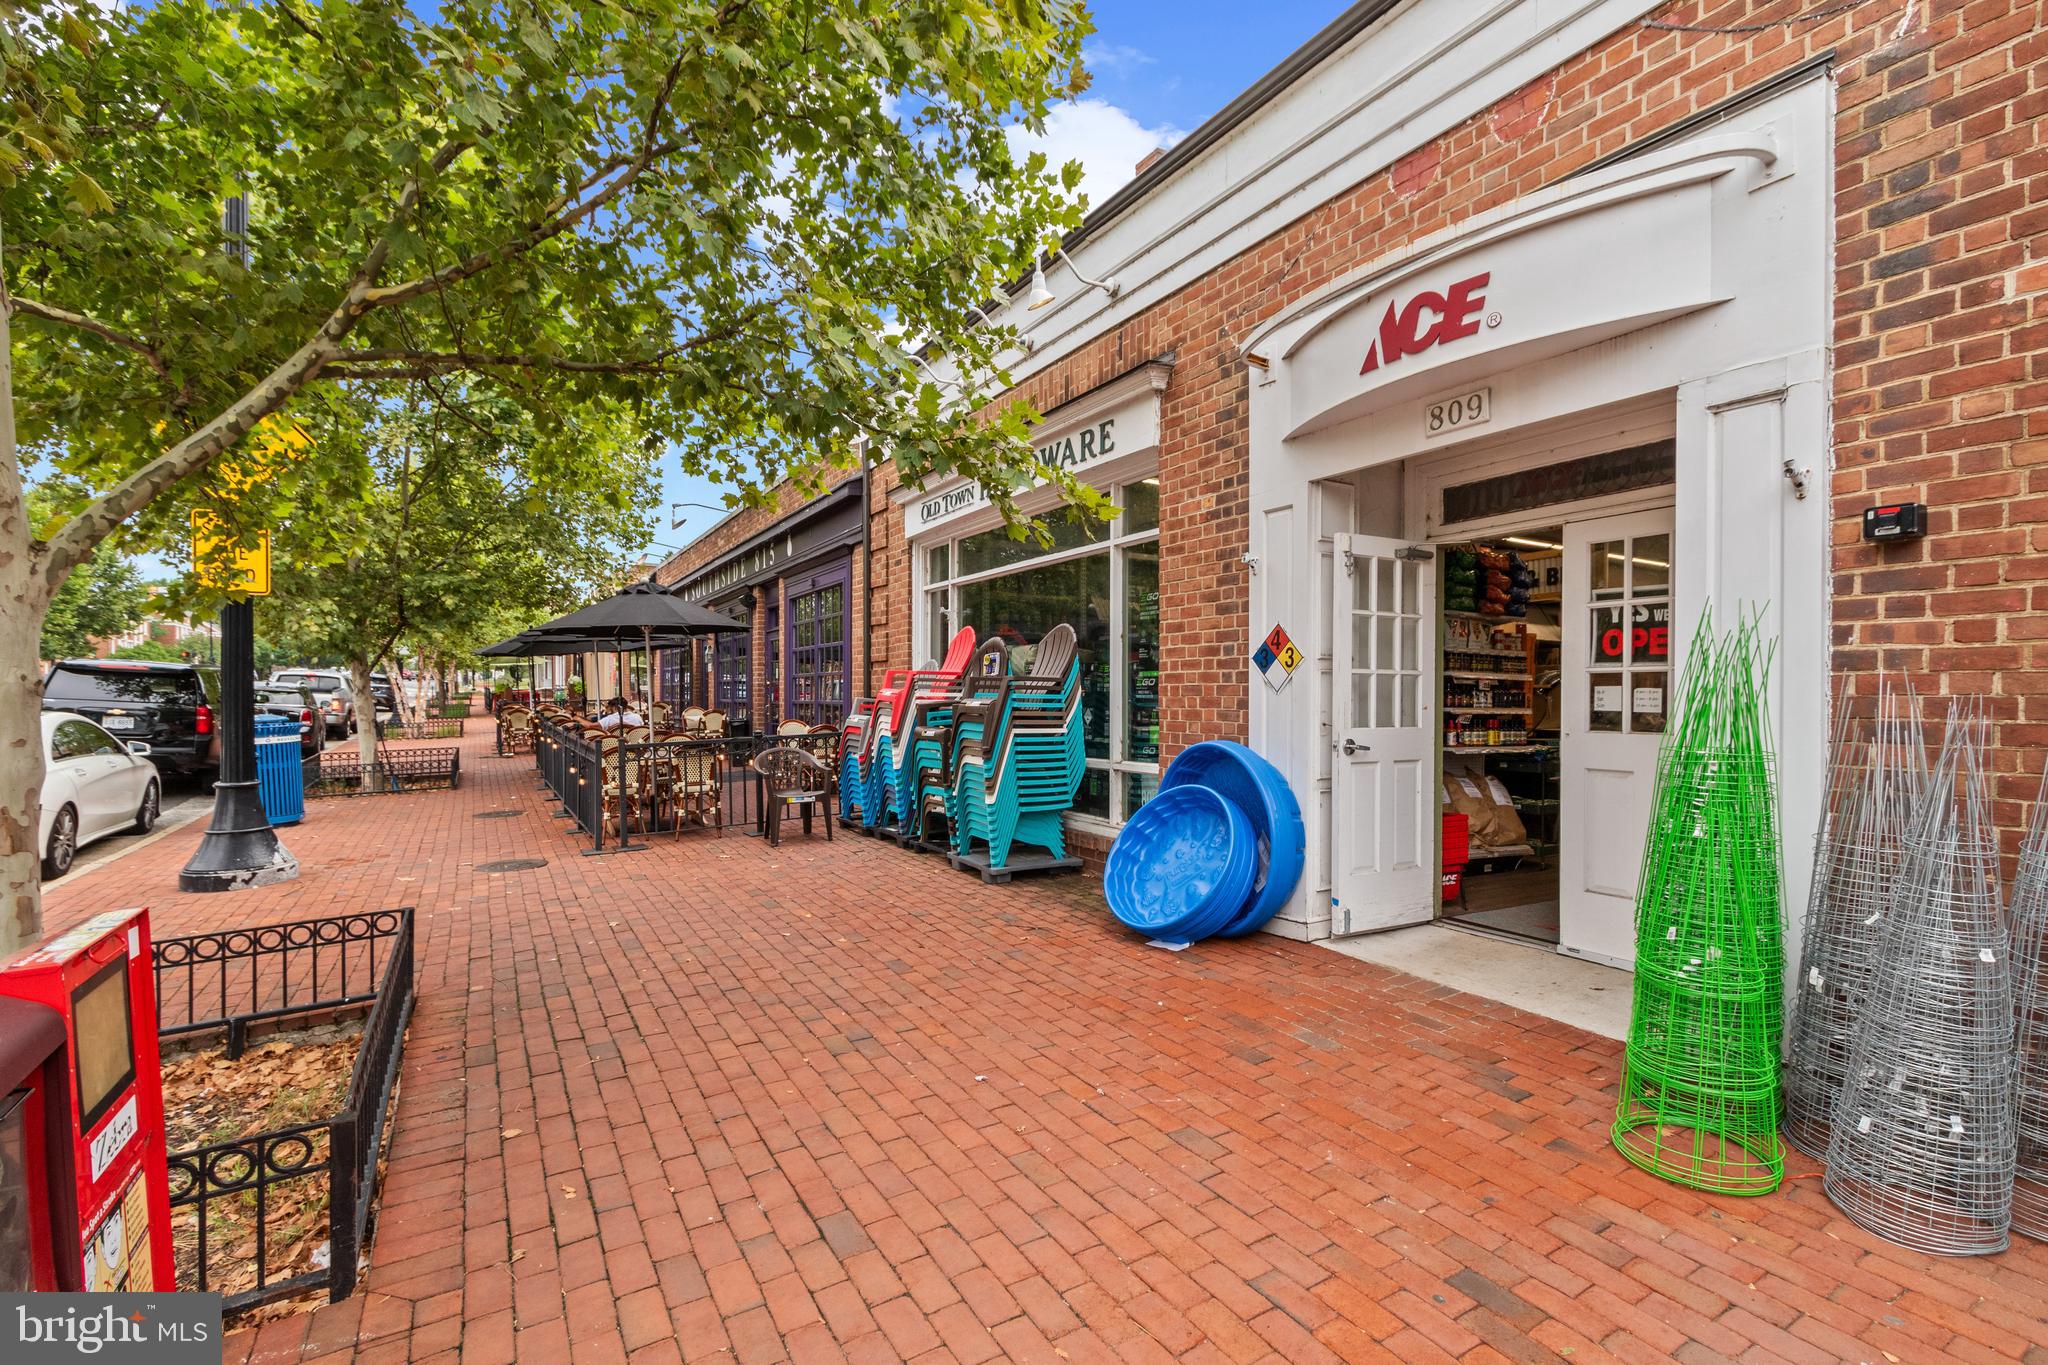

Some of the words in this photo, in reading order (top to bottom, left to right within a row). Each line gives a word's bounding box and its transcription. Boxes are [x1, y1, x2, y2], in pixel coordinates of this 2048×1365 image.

[1359, 271, 1491, 376] ACE
[1429, 393, 1483, 431] 809
[921, 501, 941, 522] OLD
[942, 485, 975, 512] TOWN
[691, 557, 747, 601] SOUTHSIDE
[754, 542, 775, 573] 815
[1610, 606, 1650, 624] YS
[1271, 630, 1281, 650] 4
[1602, 627, 1669, 656] OPE
[1260, 648, 1269, 668] 3
[1285, 647, 1294, 668] 3
